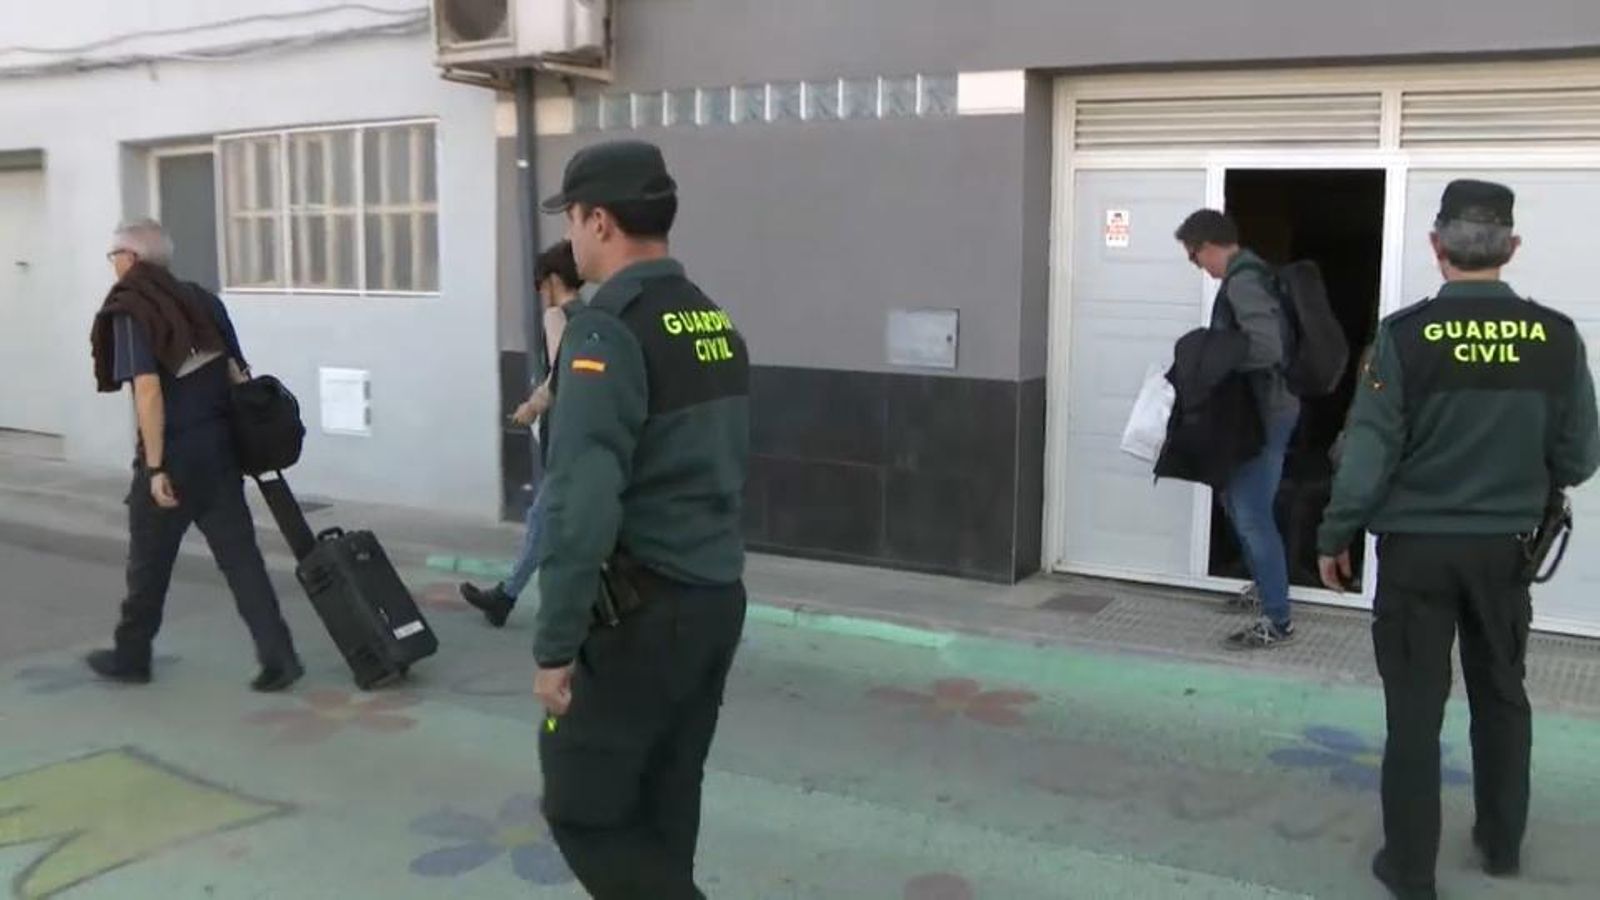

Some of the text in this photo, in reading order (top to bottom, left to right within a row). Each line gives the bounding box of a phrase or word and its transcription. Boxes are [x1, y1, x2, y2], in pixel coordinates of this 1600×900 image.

[1424, 320, 1546, 342] GUARDIA
[695, 337, 733, 361] CIVIL
[1454, 343, 1520, 363] CIVIL
